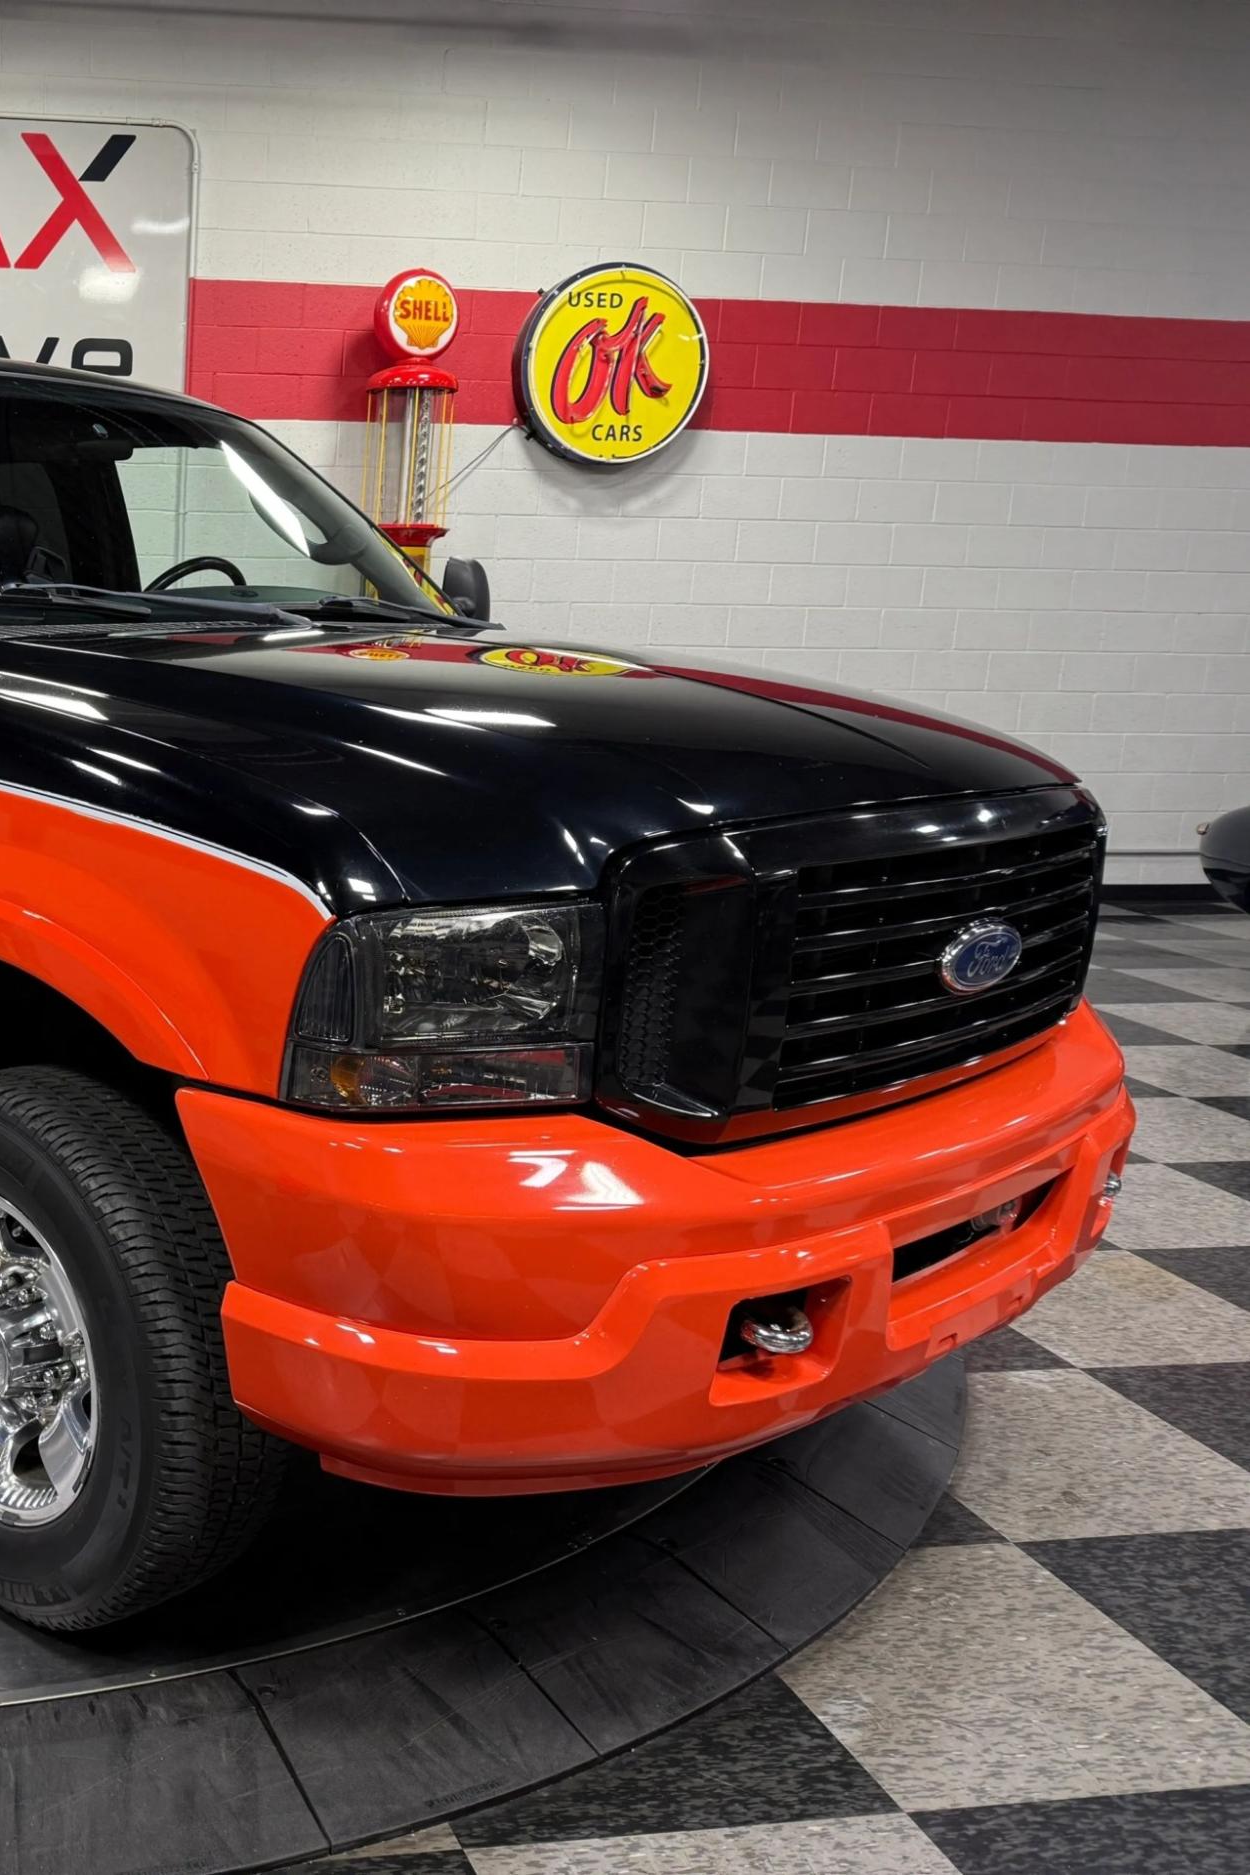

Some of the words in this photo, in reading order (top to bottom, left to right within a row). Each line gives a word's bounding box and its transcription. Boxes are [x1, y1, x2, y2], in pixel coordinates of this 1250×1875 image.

[568, 291, 624, 309] USED
[399, 300, 450, 323] SHELL
[591, 424, 643, 442] CARS
